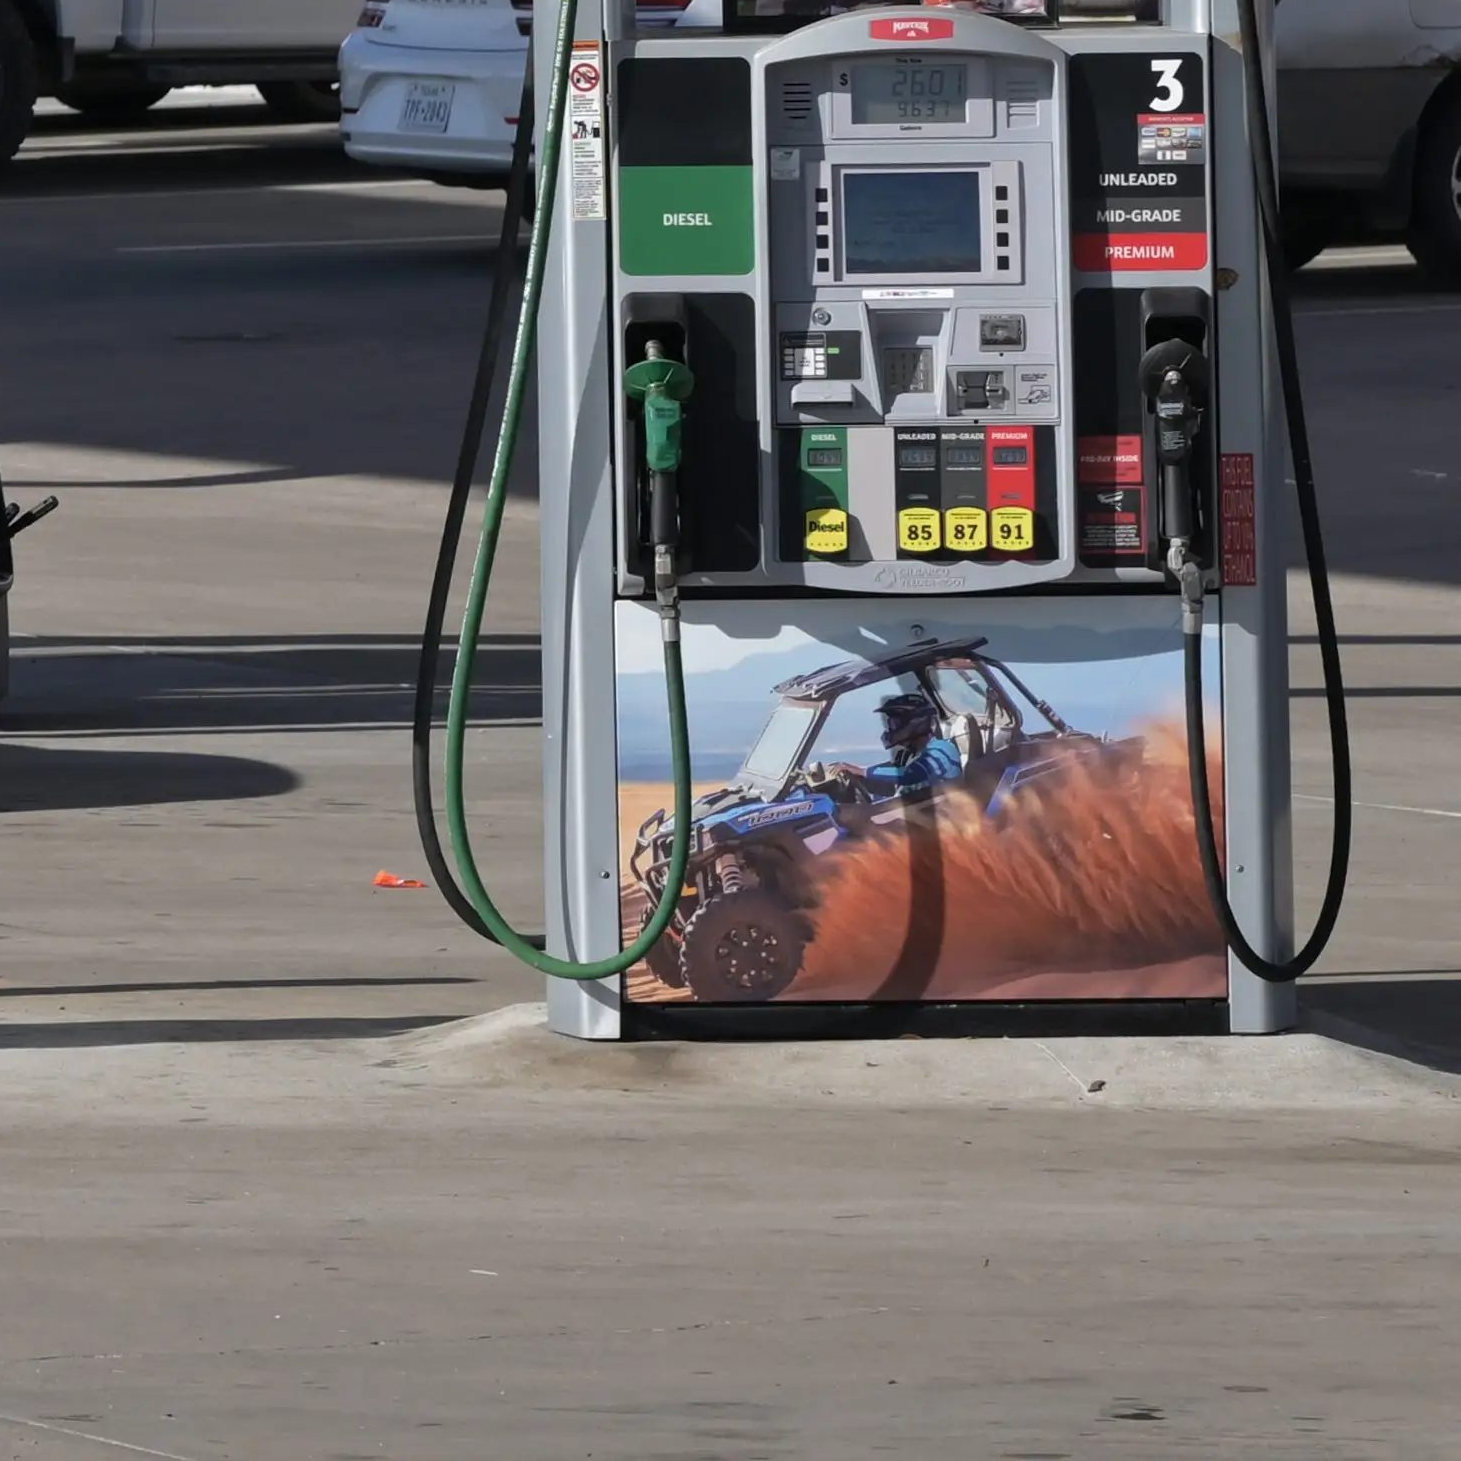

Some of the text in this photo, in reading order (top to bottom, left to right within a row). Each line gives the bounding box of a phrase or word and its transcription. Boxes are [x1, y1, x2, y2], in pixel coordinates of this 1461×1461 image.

[839, 73, 849, 87] $
[1149, 59, 1184, 112] 3
[1099, 173, 1177, 186] UNLEADED
[663, 213, 713, 226] DIESEL
[1096, 209, 1181, 223] MID-GRADE
[1105, 246, 1175, 259] PREMIUM
[811, 433, 837, 441] DIESEL
[898, 432, 936, 441] UNLEADED
[941, 432, 985, 441] MID-GRADE
[991, 432, 1028, 440] PREMIUM
[808, 520, 844, 534] Diesel
[907, 524, 932, 540] 85
[954, 524, 978, 539] 87
[1000, 523, 1024, 540] 91
